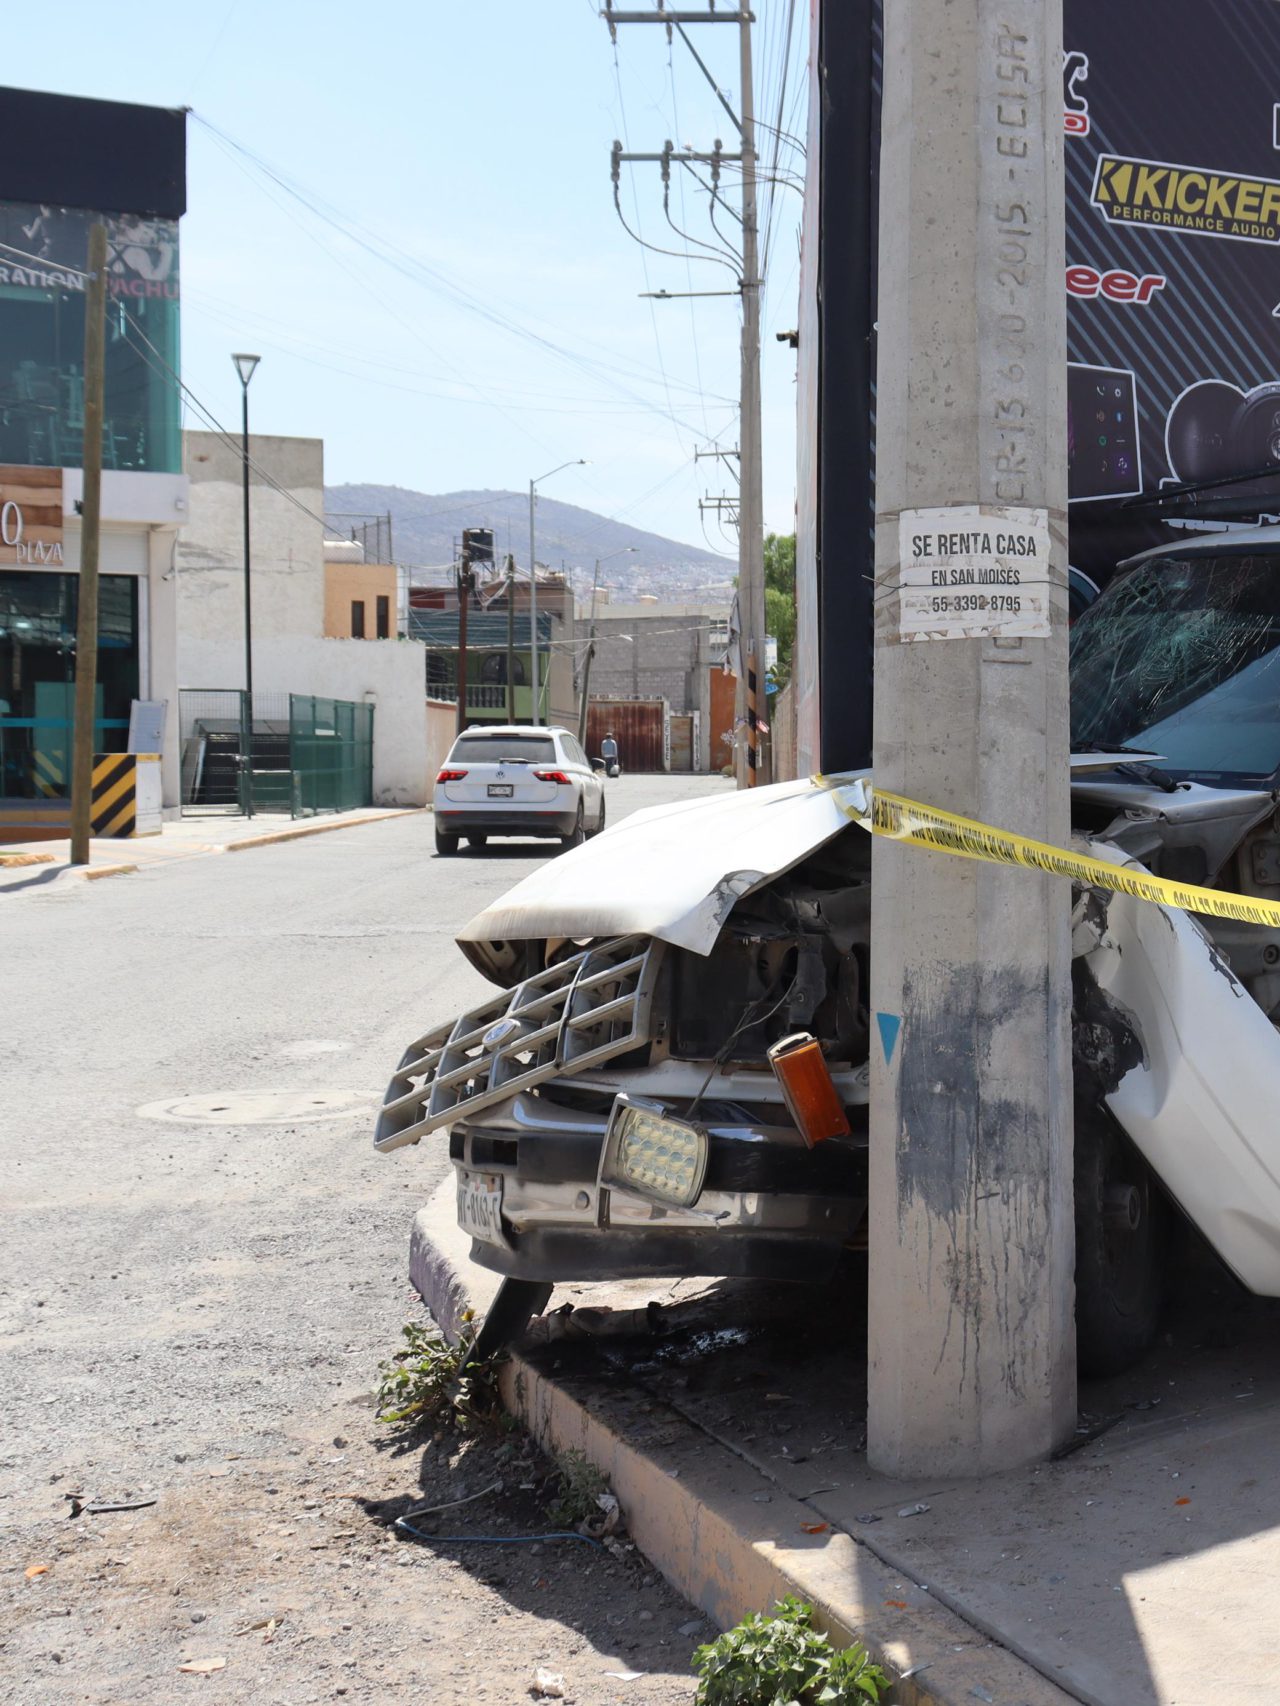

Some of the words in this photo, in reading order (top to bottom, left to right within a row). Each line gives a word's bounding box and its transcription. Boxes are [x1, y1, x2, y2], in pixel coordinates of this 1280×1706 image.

[1112, 205, 1225, 232] PERFORMANCE
[1231, 221, 1276, 239] AUDIO
[912, 534, 933, 558] SE
[937, 532, 992, 556] RENTA
[996, 533, 1037, 557] CASA
[931, 570, 947, 587] EN
[951, 568, 975, 586] SAN
[978, 566, 1020, 586] MOISÉS
[932, 594, 1021, 613] 55-3392-8795
